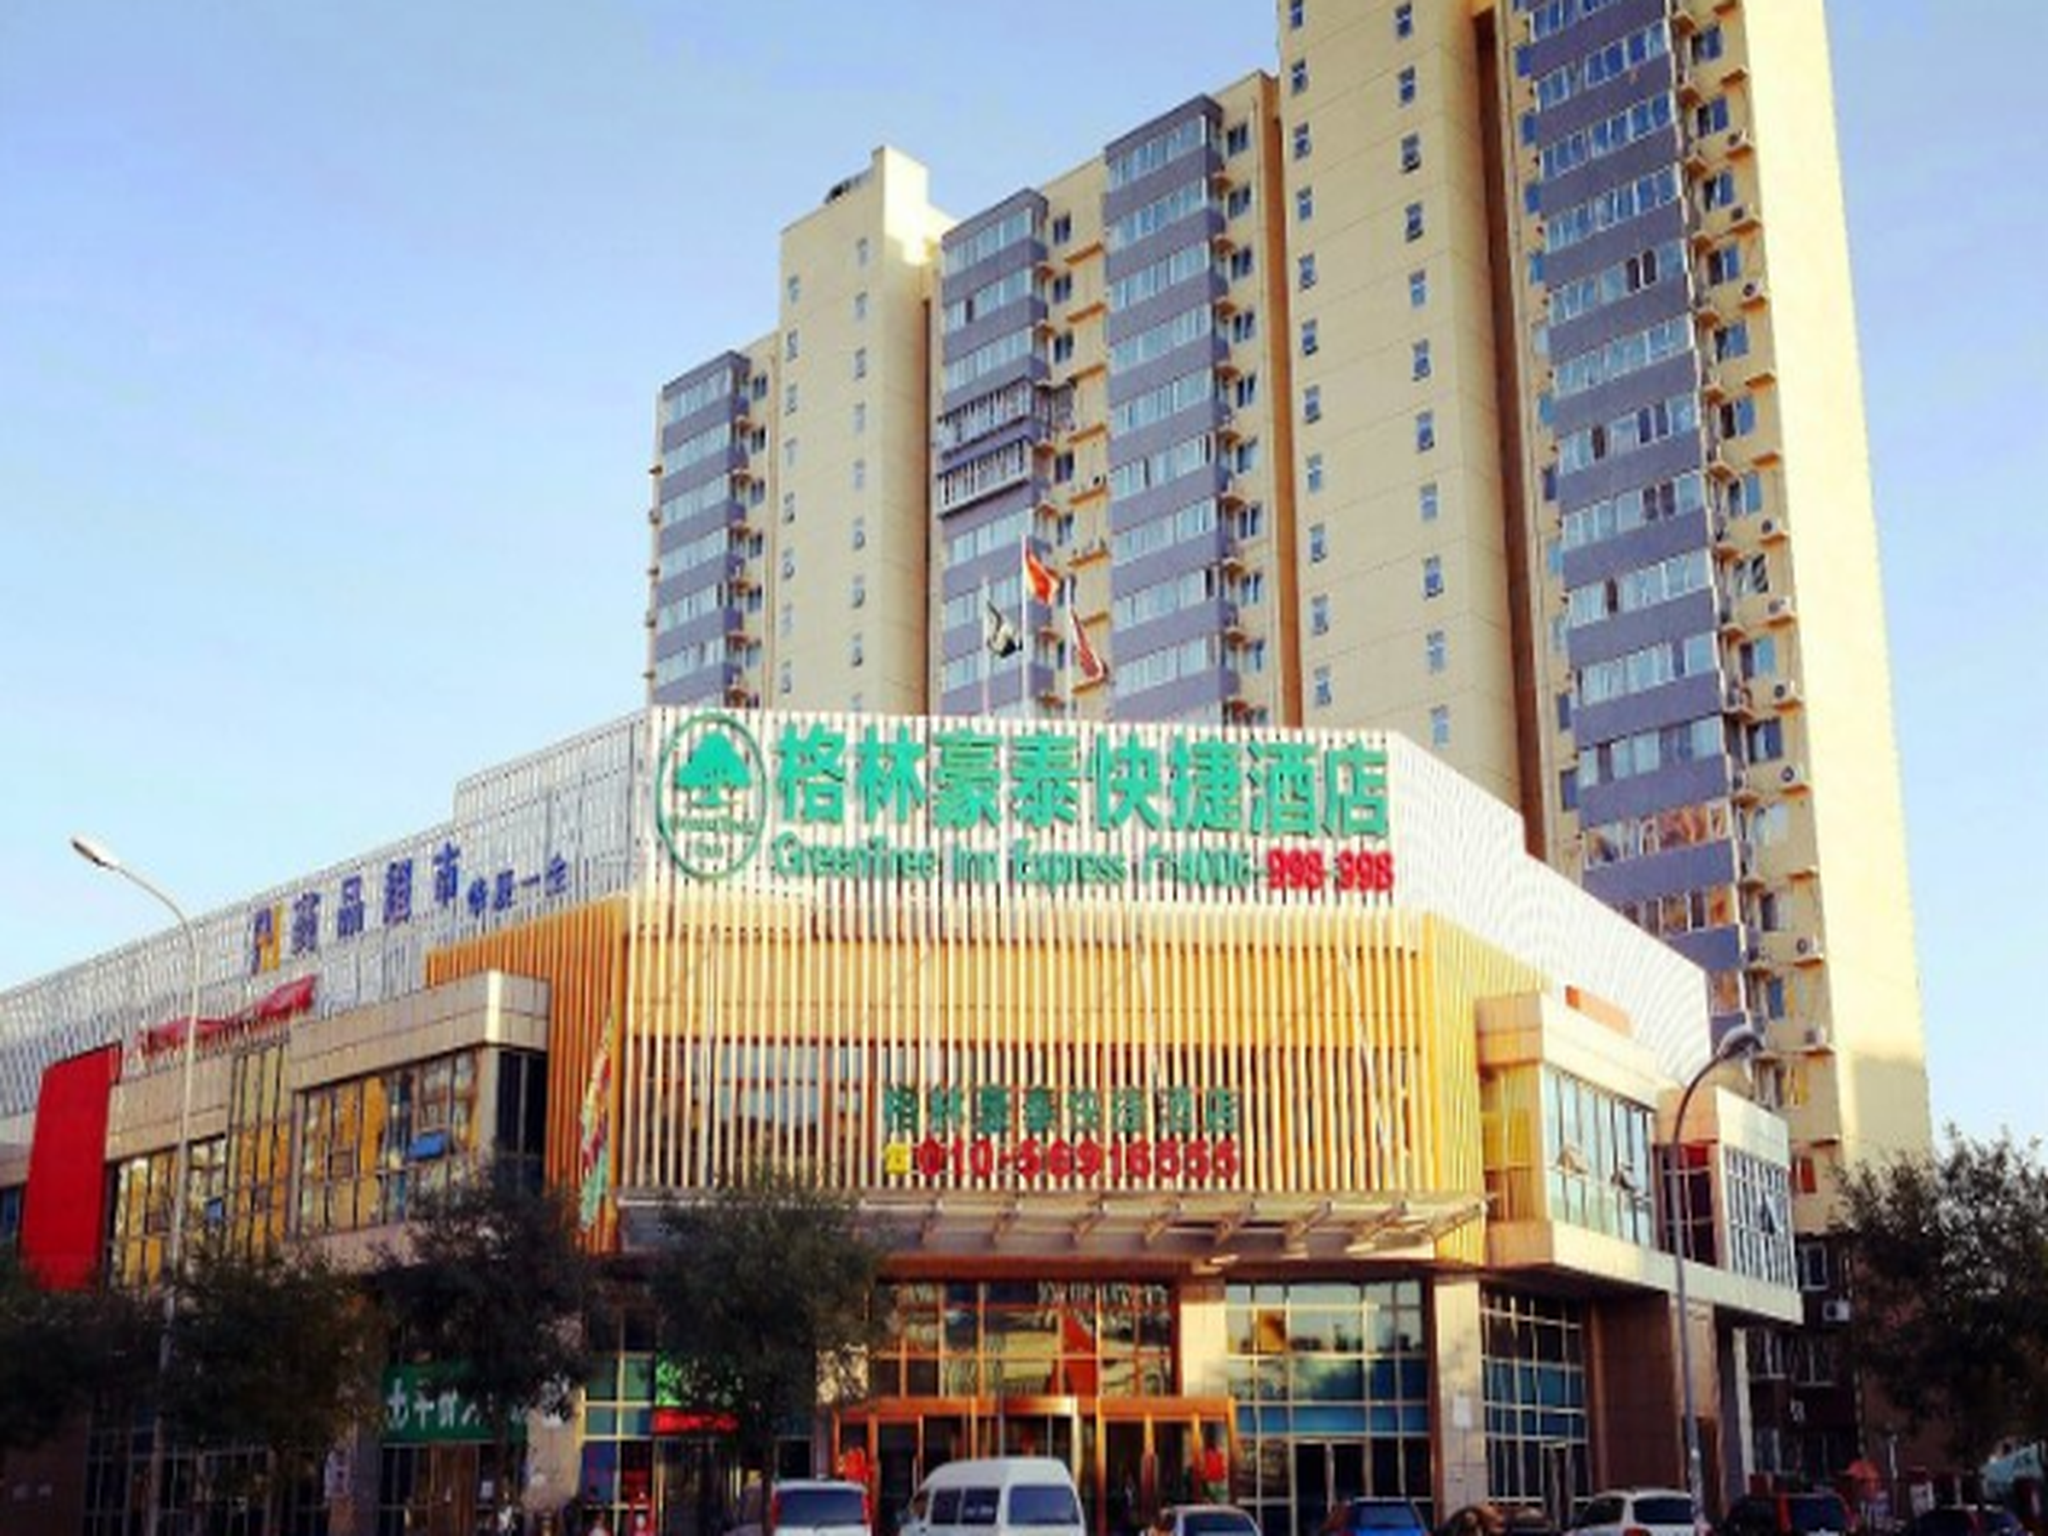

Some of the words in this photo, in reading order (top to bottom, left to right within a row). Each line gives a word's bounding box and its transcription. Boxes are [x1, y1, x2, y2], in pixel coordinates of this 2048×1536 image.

[773, 722, 1388, 839] 格林豪泰快捷酒店
